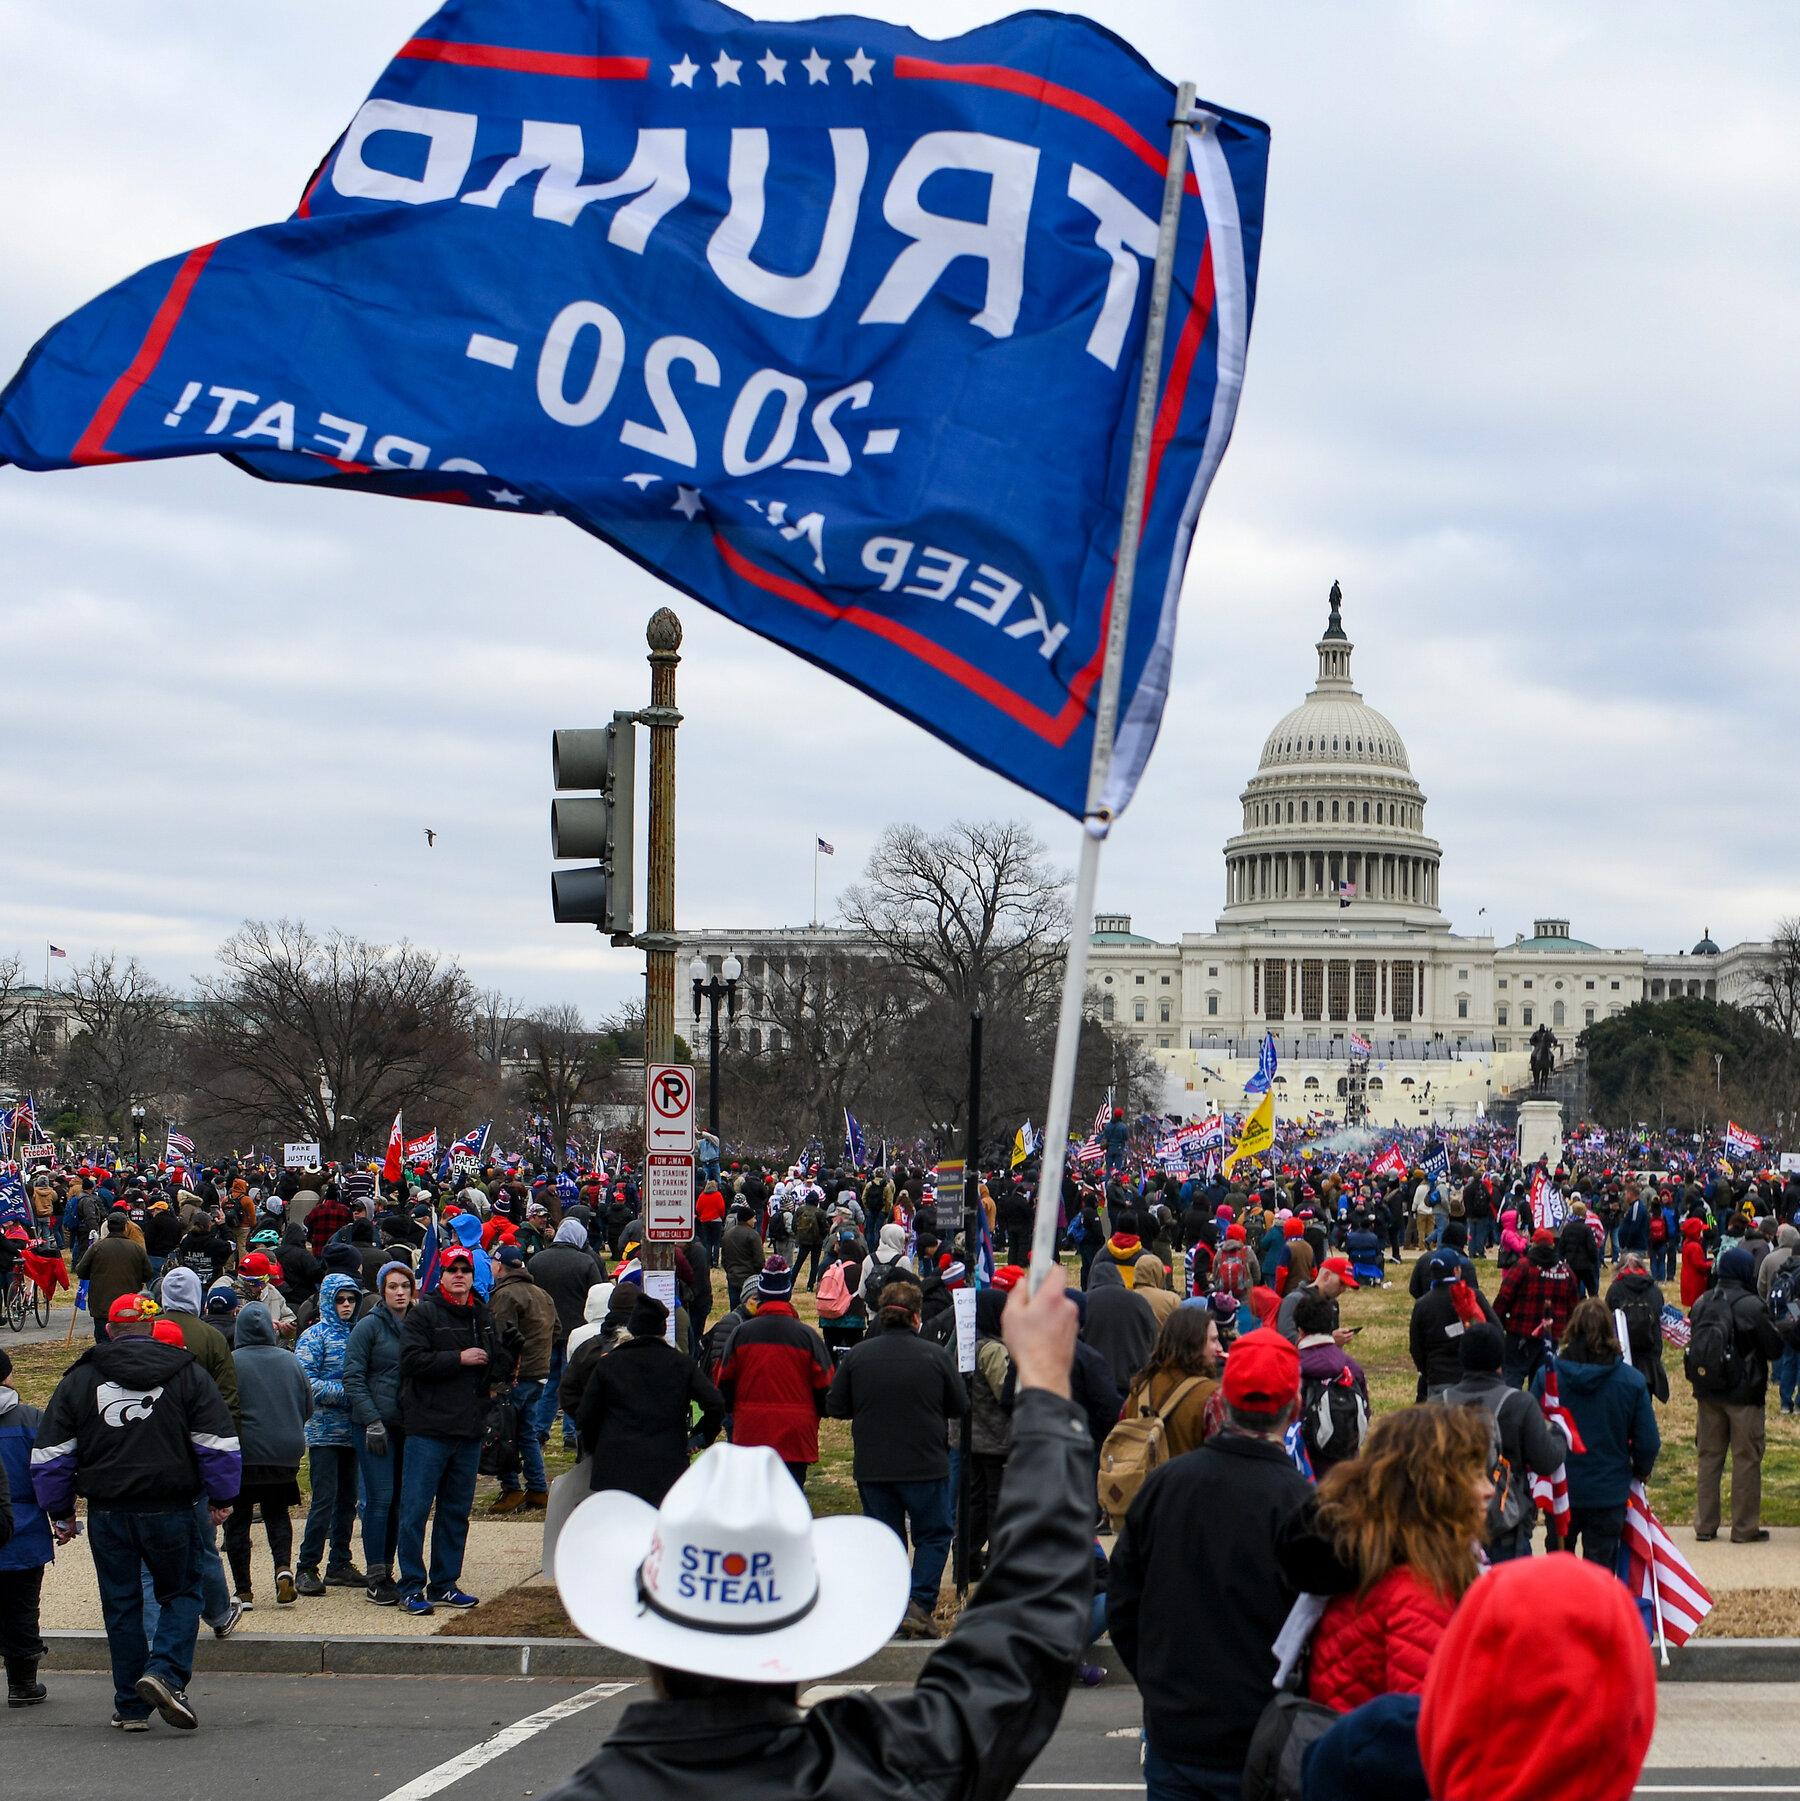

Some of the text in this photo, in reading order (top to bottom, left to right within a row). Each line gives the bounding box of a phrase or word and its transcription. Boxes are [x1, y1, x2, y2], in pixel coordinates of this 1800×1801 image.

[455, 1155, 480, 1167] PAPER
[654, 1156, 686, 1165] TOW AWAY
[1660, 1312, 1691, 1337] TRUMP
[681, 1544, 772, 1577] STOP
[679, 1573, 782, 1604] STEAL
